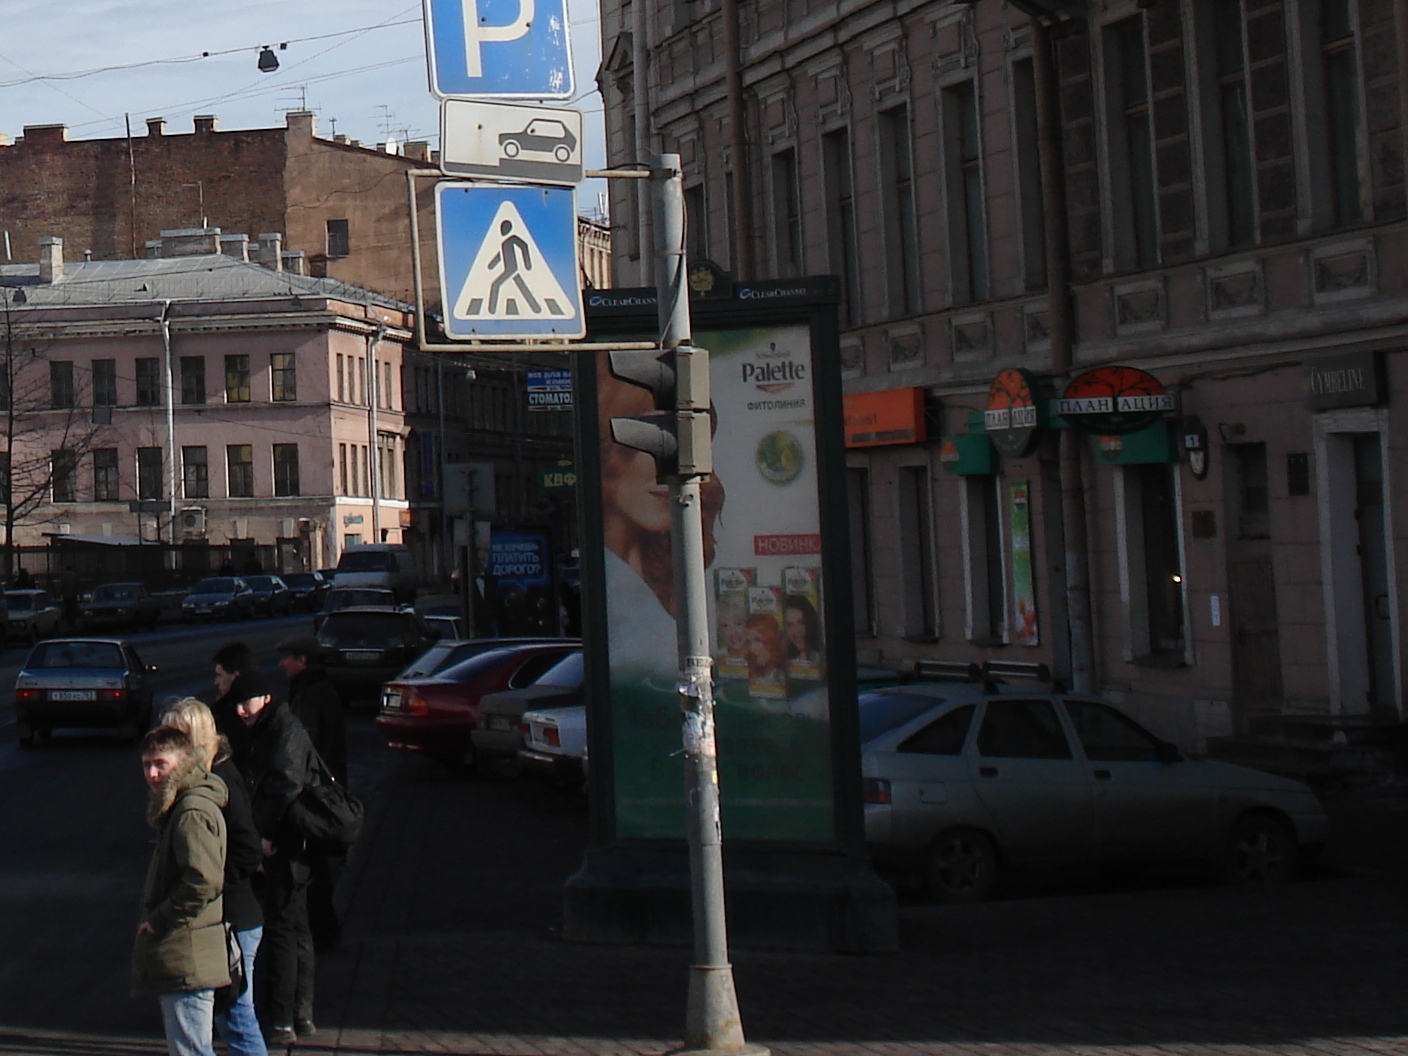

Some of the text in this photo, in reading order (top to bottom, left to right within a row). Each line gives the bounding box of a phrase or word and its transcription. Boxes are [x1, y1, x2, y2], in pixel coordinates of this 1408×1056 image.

[602, 297, 657, 306] CLEARCHANN
[742, 360, 805, 383] Palette
[492, 552, 540, 563] ПЛАТИТЬ
[492, 564, 541, 575] ДОРОГО?
